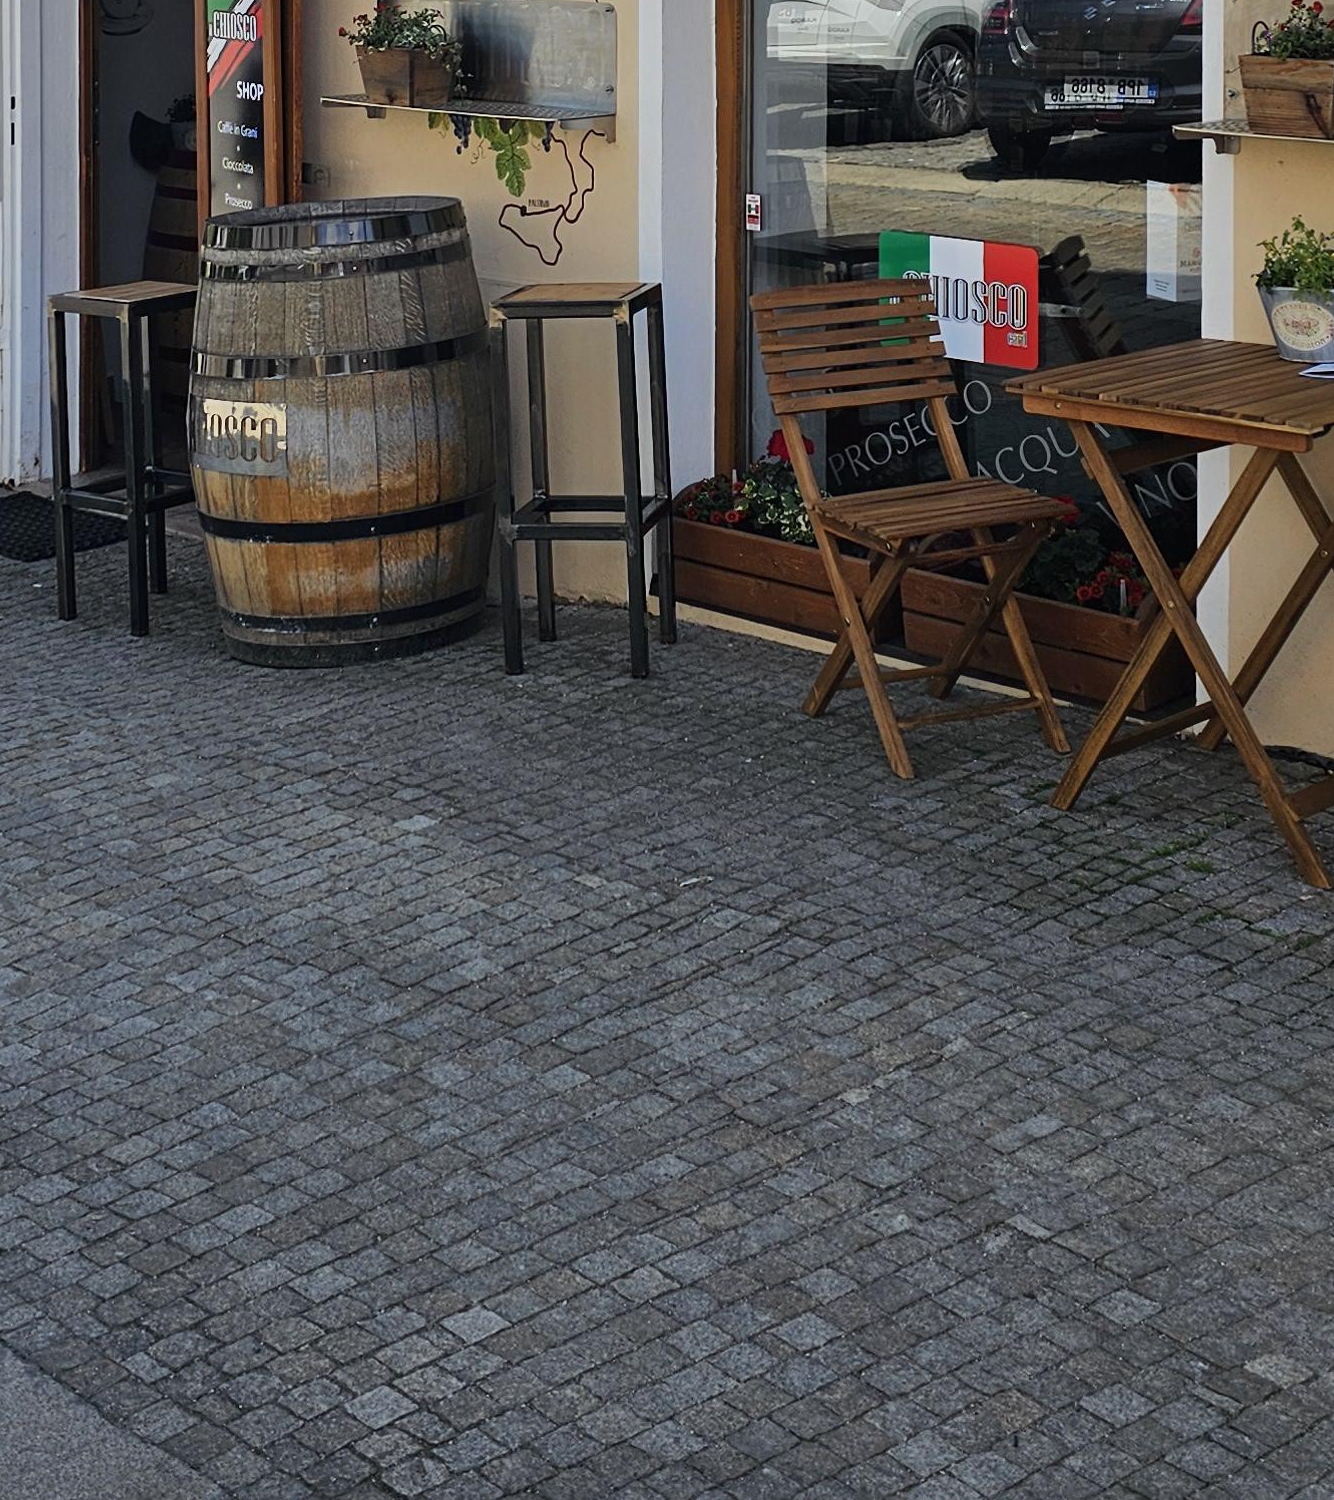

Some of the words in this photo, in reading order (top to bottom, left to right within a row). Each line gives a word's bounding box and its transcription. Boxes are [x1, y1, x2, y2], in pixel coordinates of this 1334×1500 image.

[213, 10, 257, 42] CHIOSCO
[236, 80, 264, 101] SHOP
[240, 124, 258, 139] Grani
[222, 156, 254, 175] Cioccolata
[224, 192, 253, 210] Prosecco
[903, 271, 1029, 331] HIOSCO
